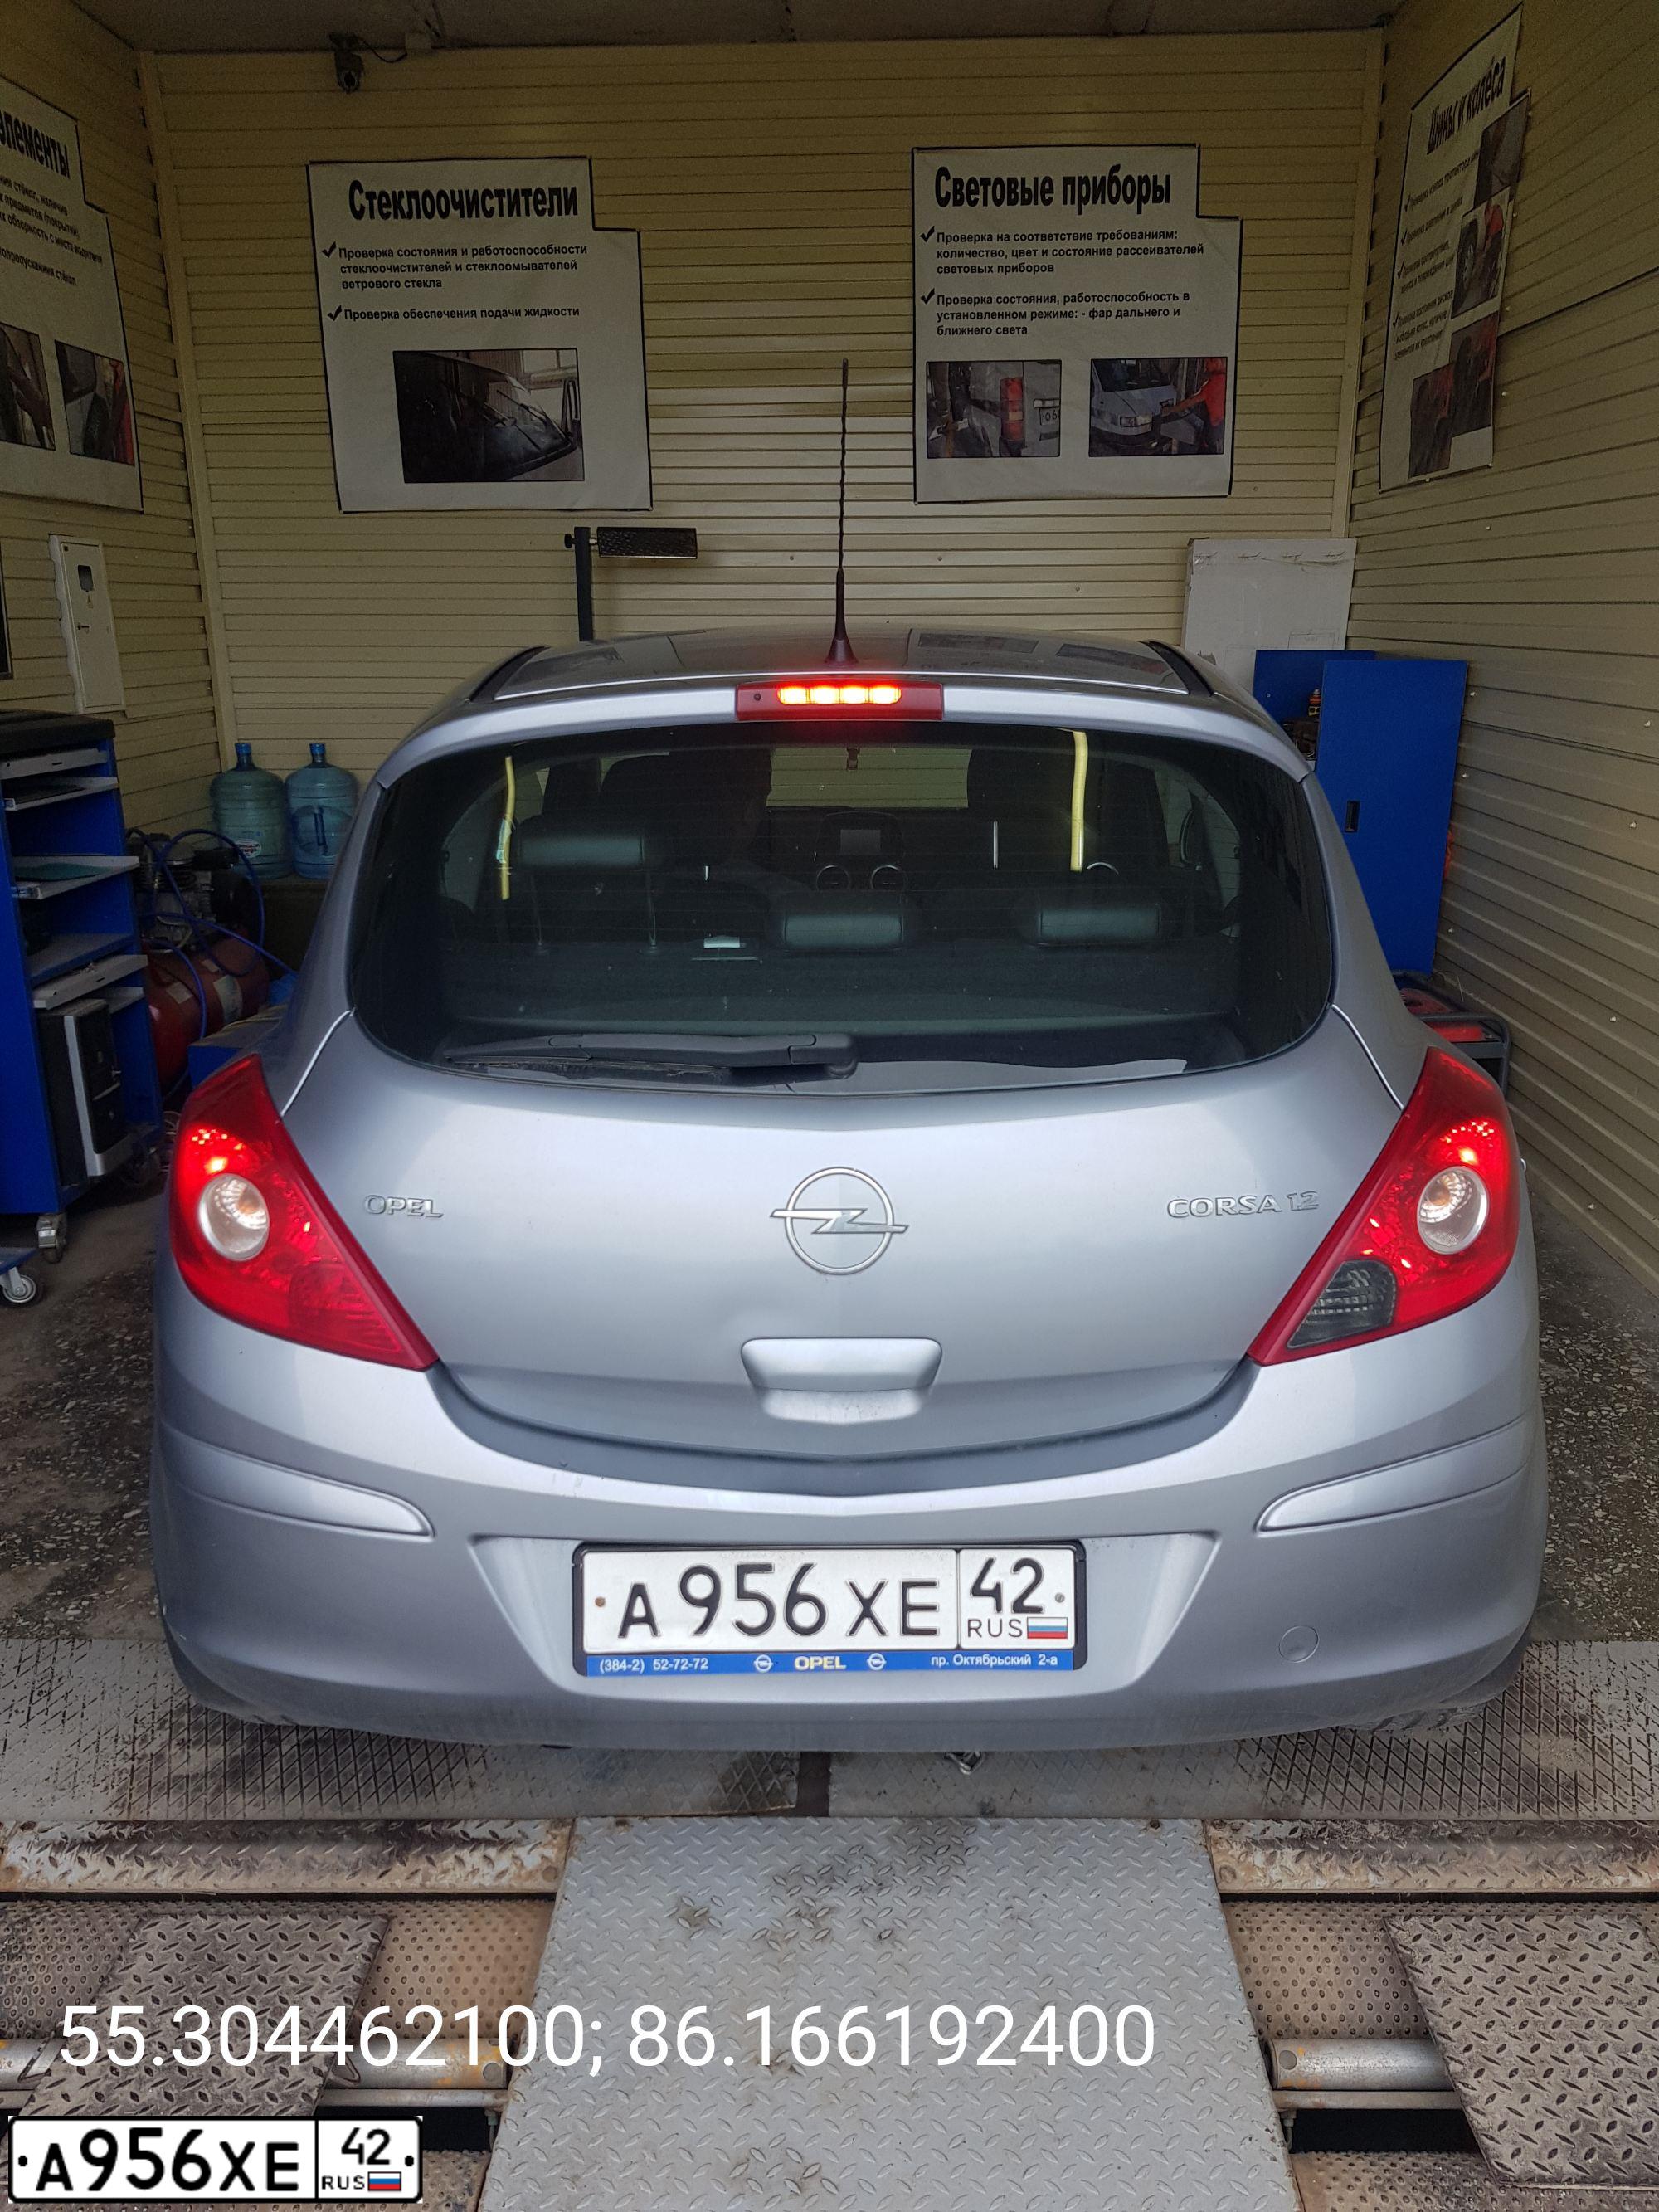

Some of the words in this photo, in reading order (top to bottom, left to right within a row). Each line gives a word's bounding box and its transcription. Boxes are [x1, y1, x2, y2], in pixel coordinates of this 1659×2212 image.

[1427, 100, 1458, 155] Шины
[1467, 56, 1506, 124] колеса
[934, 166, 1055, 207] Световые
[1062, 163, 1171, 216] приборы
[348, 179, 578, 221] Стеклоочистители
[937, 231, 993, 246] Проверка
[996, 233, 1010, 242] на
[1013, 232, 1093, 242] соответствие
[1096, 228, 1178, 243] требованиям:
[338, 247, 394, 261] Проверка
[397, 248, 458, 258] состояния
[460, 247, 469, 256] и
[471, 243, 587, 259] работоспособности
[937, 249, 1008, 260] количество,
[1011, 249, 1039, 260] цвет
[1041, 248, 1048, 257] и
[1051, 247, 1113, 257] состояние
[1116, 242, 1204, 259] рассеивателей
[340, 258, 452, 274] стеклоочистителей
[455, 263, 463, 272] и
[465, 257, 577, 272] стеклоомывателей
[937, 265, 994, 275] световых
[997, 261, 1055, 275] приборов
[341, 280, 401, 292] ветрового
[404, 279, 442, 289] стекла
[937, 294, 993, 308] Проверка
[995, 295, 1060, 305] состояния,
[1063, 290, 1180, 306] работоспособность
[1183, 292, 1190, 301] в
[343, 309, 400, 322] Проверка
[402, 308, 478, 319] обеспечения
[480, 309, 522, 319] подачи
[523, 308, 580, 318] жидкости
[937, 310, 1027, 324] установленном
[1030, 310, 1078, 322] режиме:
[1088, 307, 1112, 321] фар
[1115, 308, 1170, 319] дальнего
[1173, 308, 1180, 317] и
[937, 324, 993, 336] ближнего
[995, 326, 1028, 335] света
[364, 1194, 444, 1218] OPEL
[1167, 1194, 1282, 1218] CORSA
[971, 1557, 1044, 1614] 42
[967, 1618, 1024, 1639] RUS
[599, 1659, 645, 1674] (384-2)
[653, 1657, 709, 1671] 52-72-72
[795, 1655, 847, 1670] OPEL
[931, 1656, 949, 1668] пр.
[953, 1654, 1031, 1668] Октябрьский
